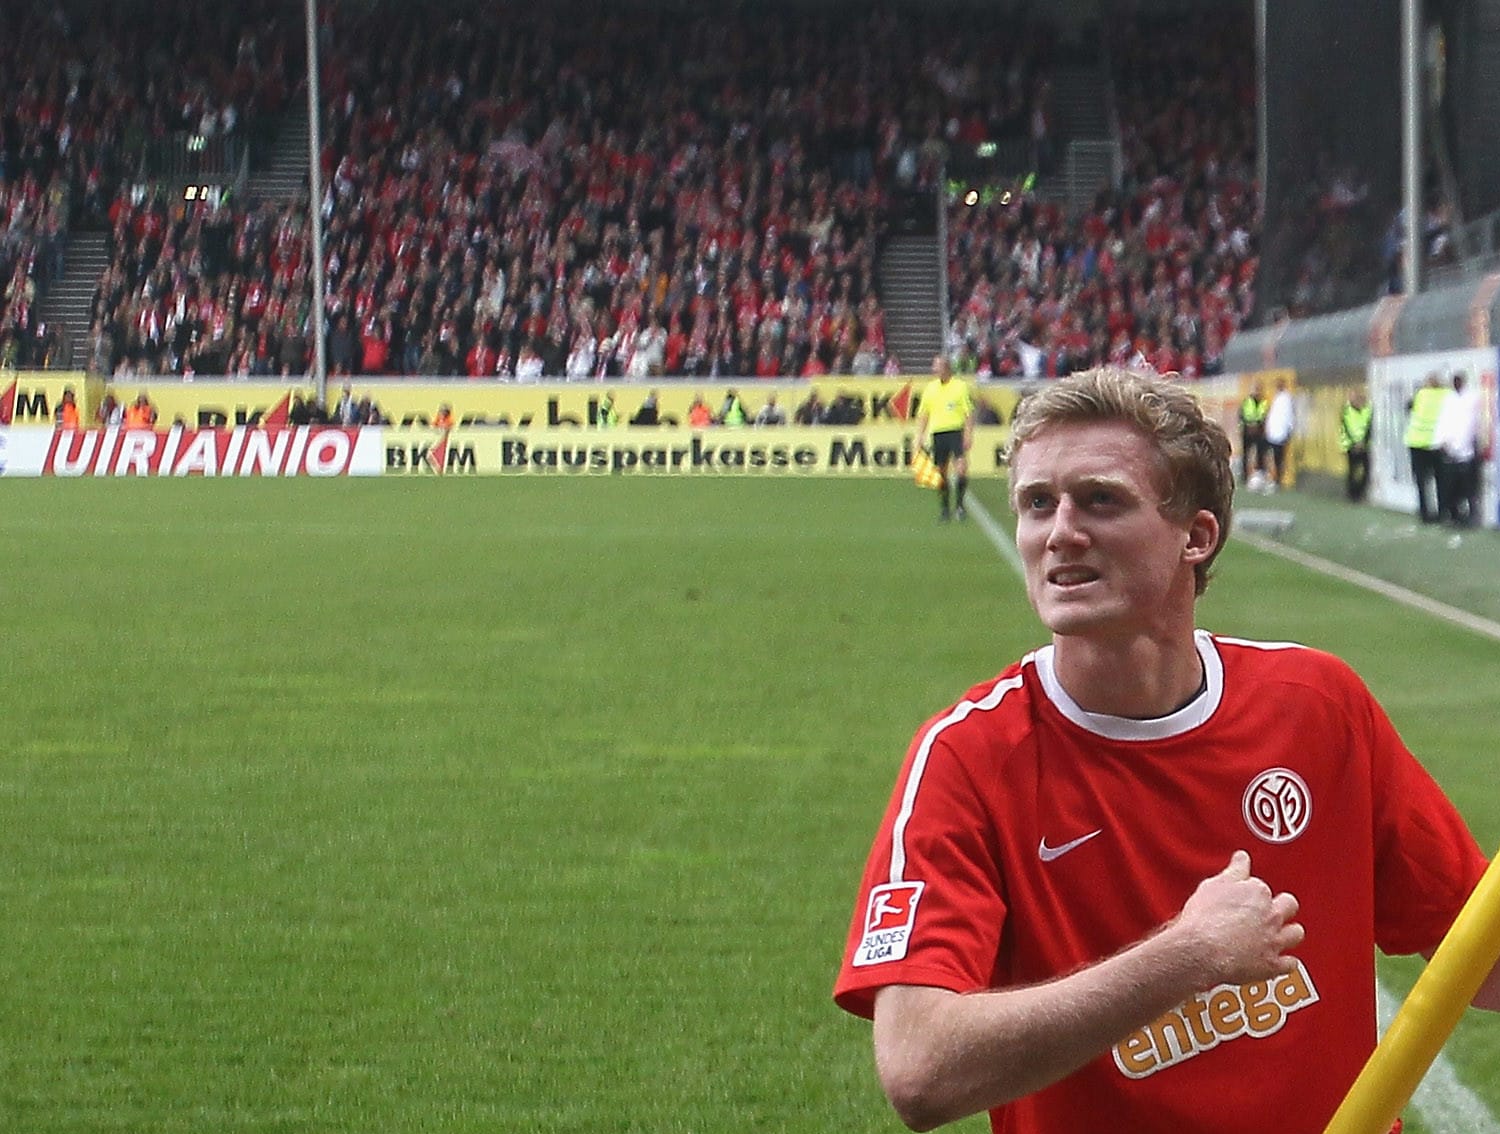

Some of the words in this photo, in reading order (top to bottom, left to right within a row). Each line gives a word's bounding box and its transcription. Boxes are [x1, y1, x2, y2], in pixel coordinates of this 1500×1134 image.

[386, 446, 477, 468] BKM
[501, 439, 818, 472] Bausparkasse
[829, 437, 913, 467] Mai
[866, 945, 893, 961] LIGA
[1117, 968, 1311, 1074] entega
